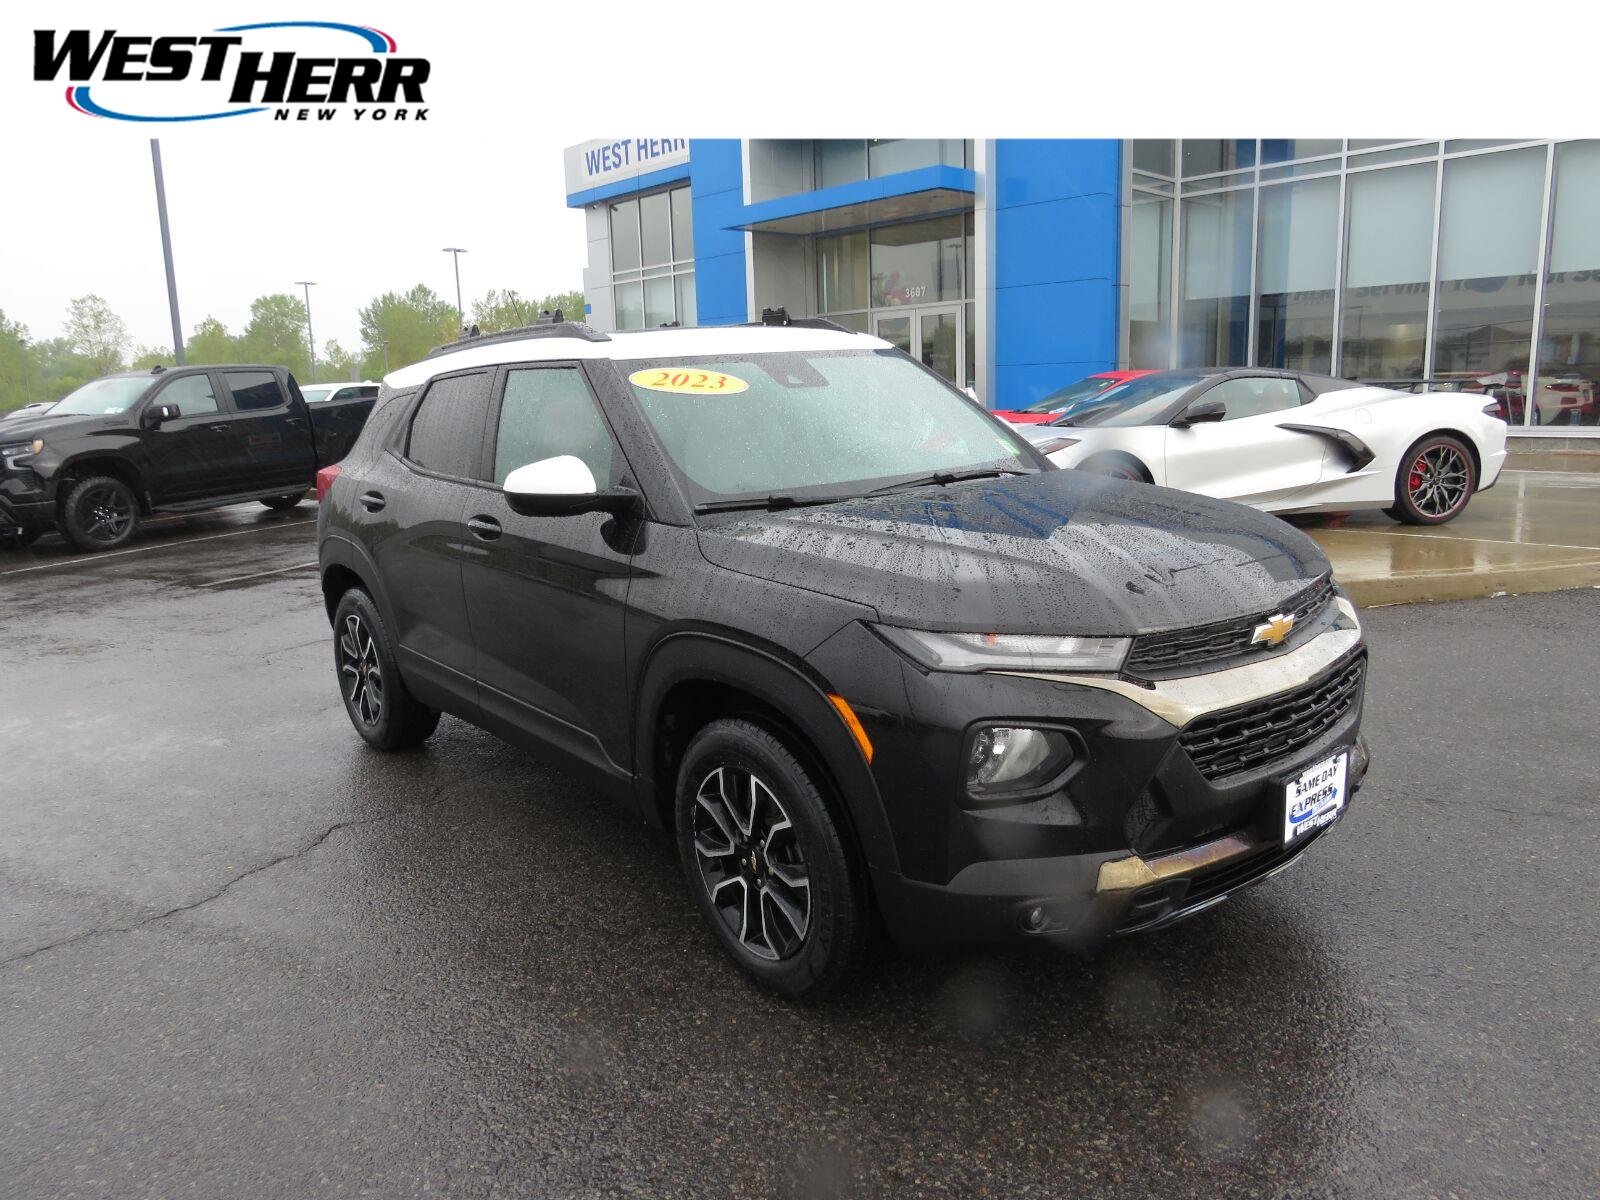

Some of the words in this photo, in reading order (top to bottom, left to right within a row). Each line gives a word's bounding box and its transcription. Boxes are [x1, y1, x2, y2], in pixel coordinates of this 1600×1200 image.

[585, 139, 632, 176] WEST
[651, 372, 728, 389] 2023
[1295, 774, 1320, 798] SAME
[1321, 764, 1339, 782] DAY
[1291, 783, 1334, 817] EXPRESS
